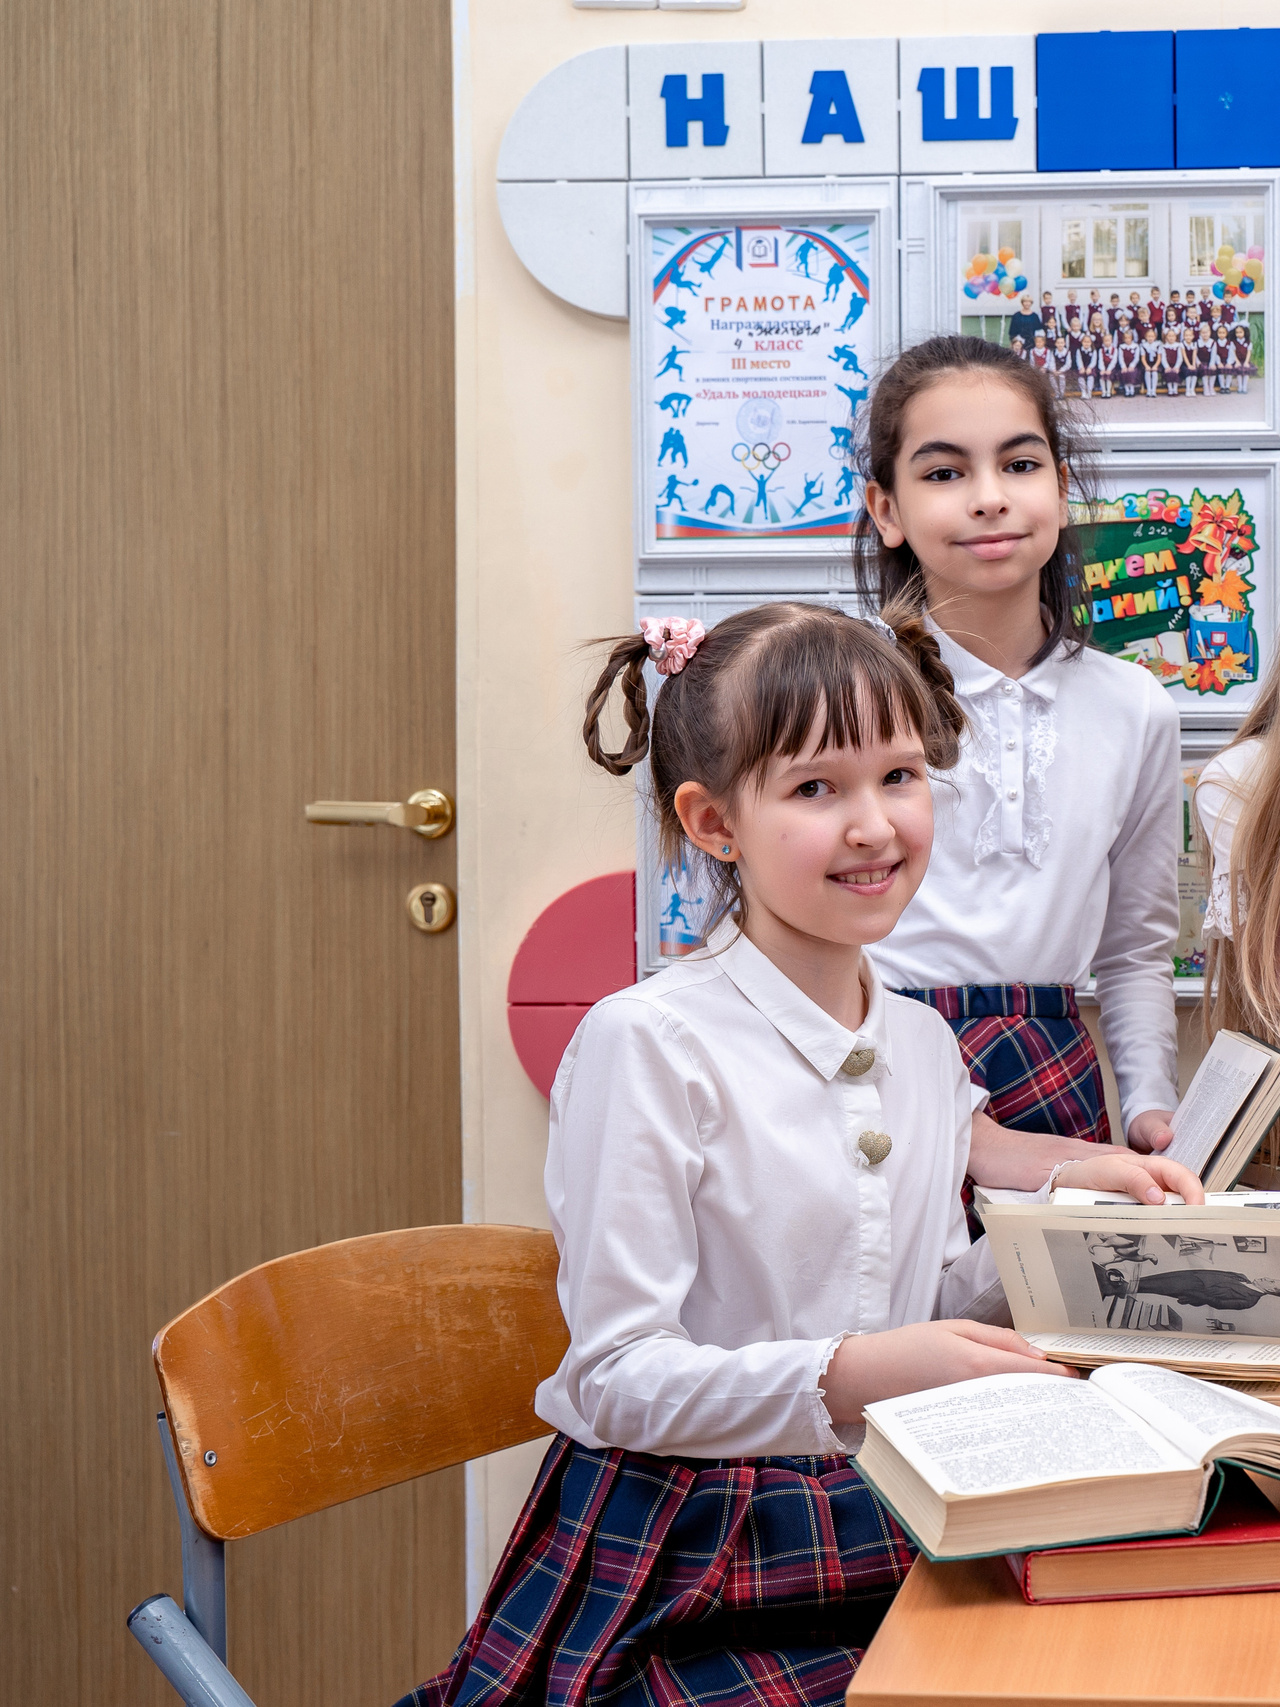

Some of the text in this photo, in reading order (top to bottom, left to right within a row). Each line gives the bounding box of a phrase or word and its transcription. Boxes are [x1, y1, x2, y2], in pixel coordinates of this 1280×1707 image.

[660, 65, 1019, 148] НАШ
[704, 295, 816, 312] ГРАМОТА
[710, 319, 811, 333] Награждается
[754, 339, 804, 351] класс
[731, 358, 791, 370] III место
[695, 389, 827, 400] «Удаль молодецкая»
